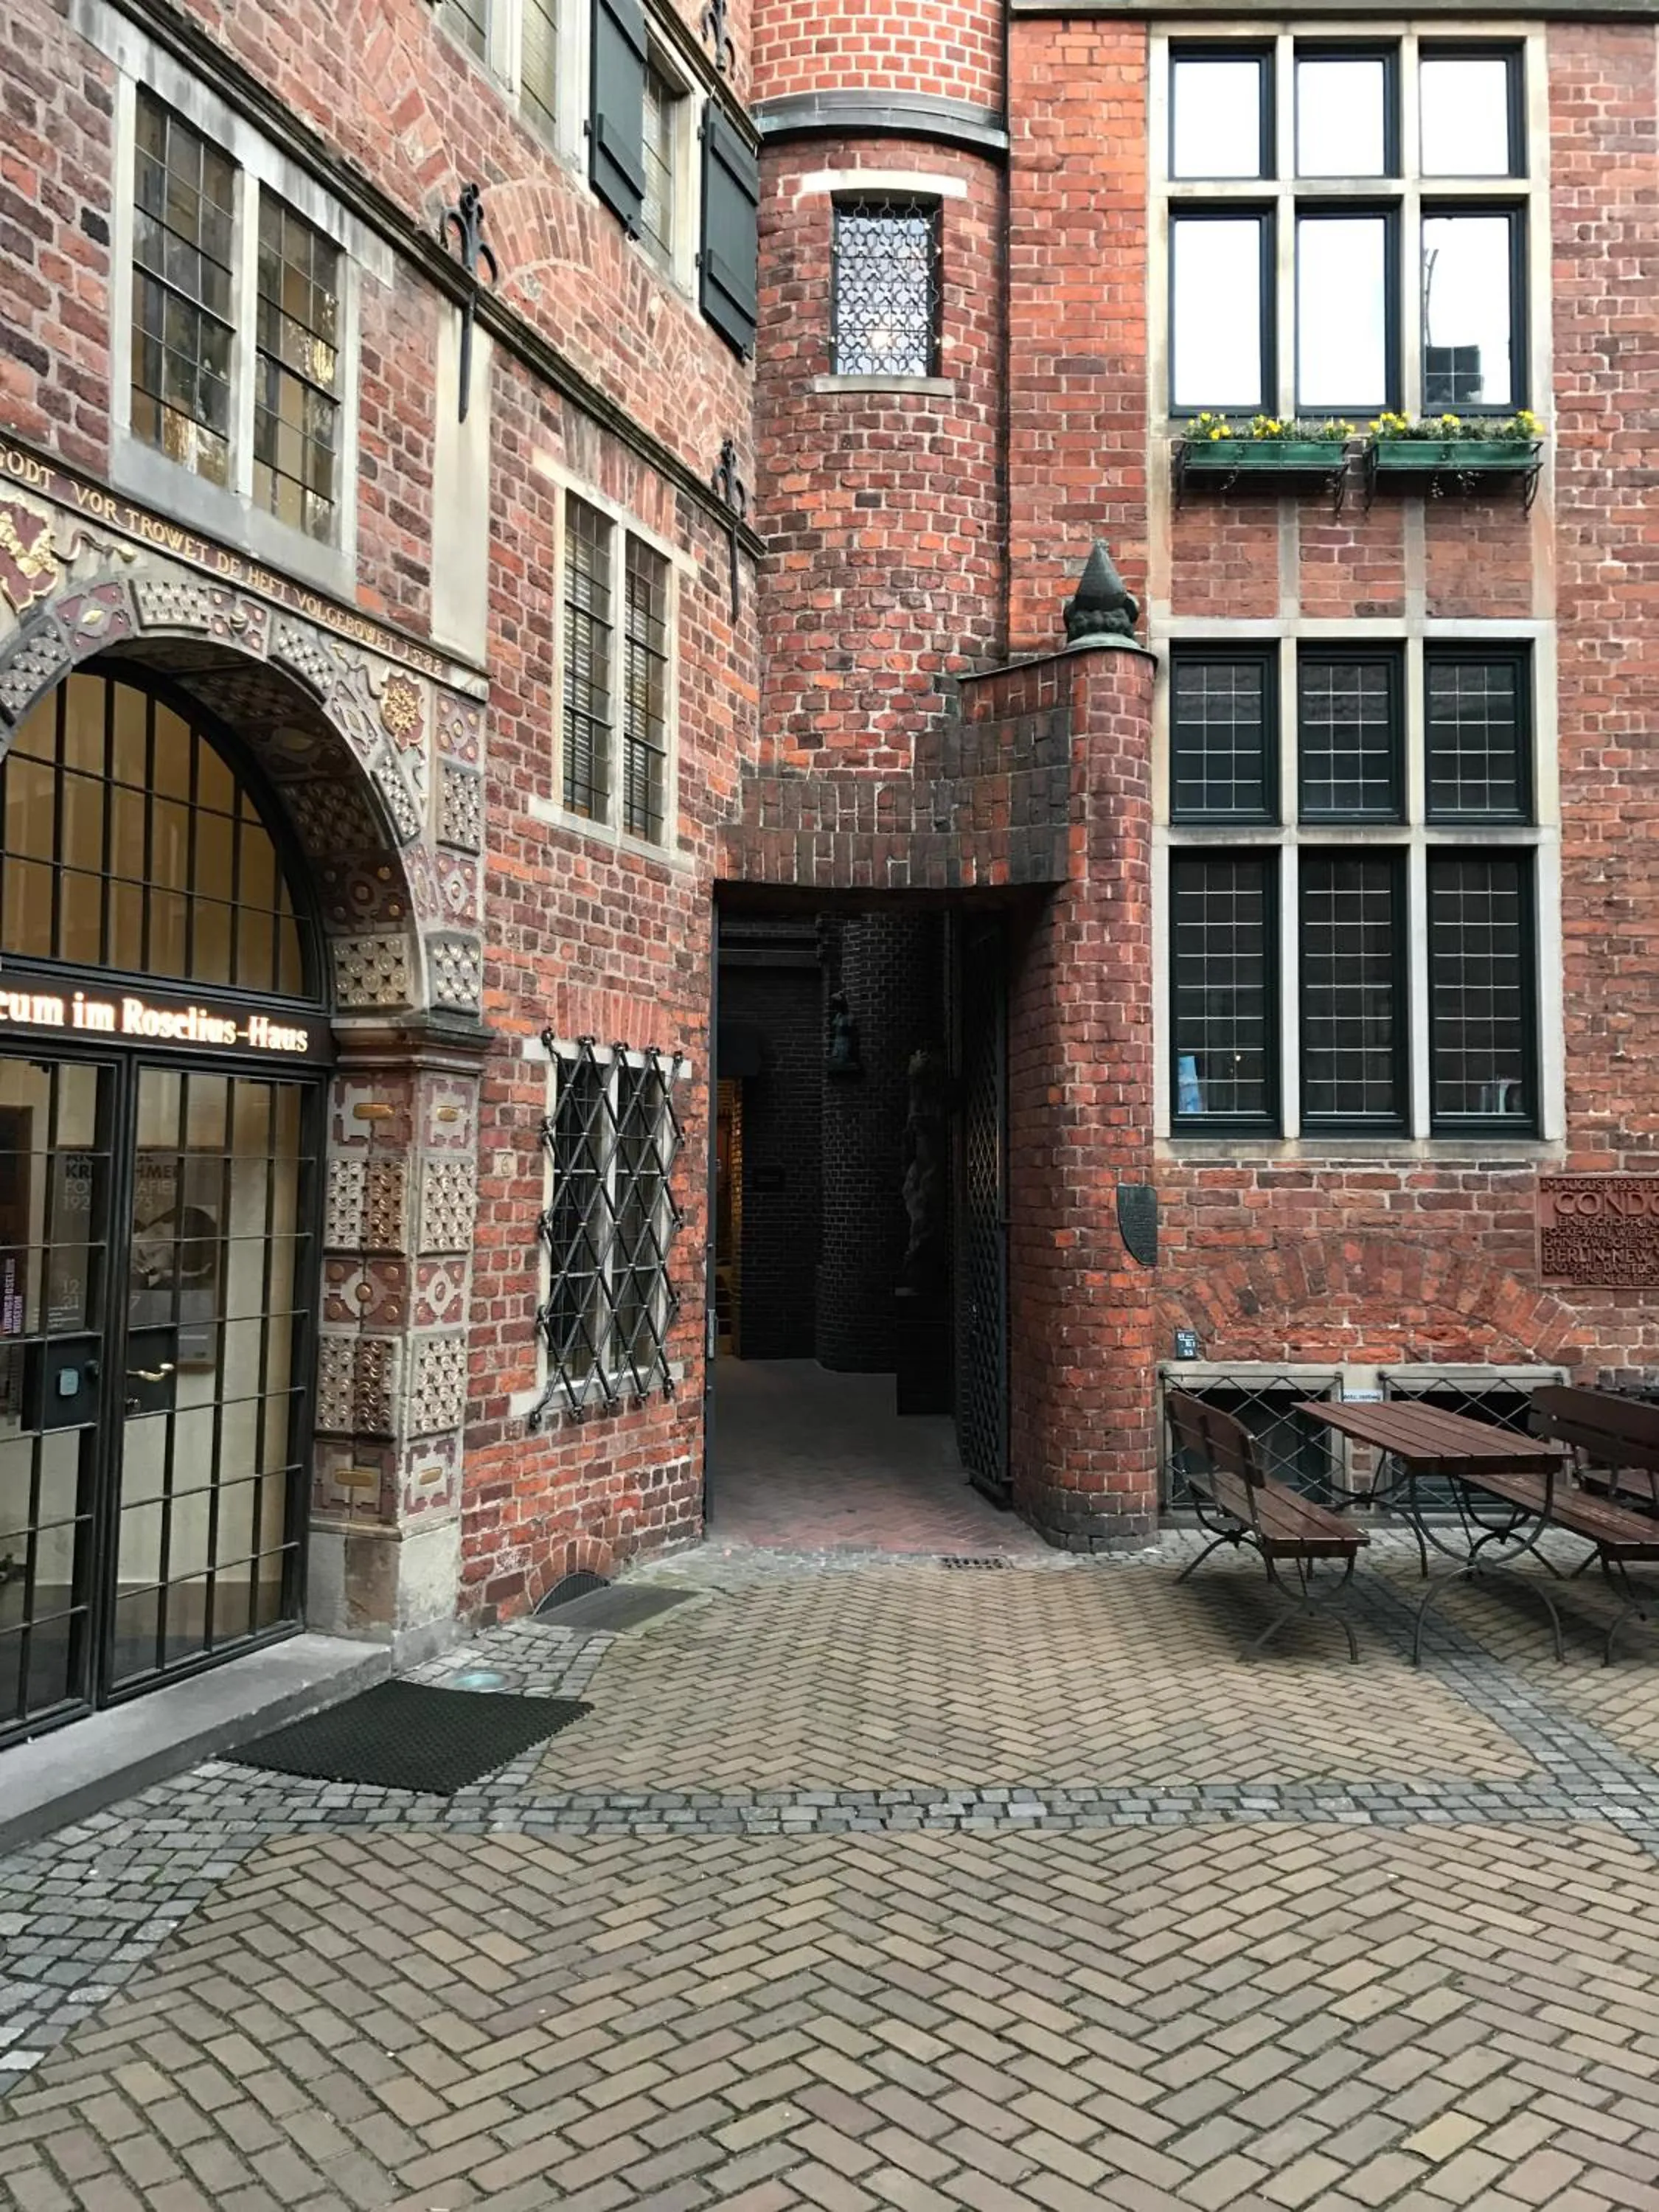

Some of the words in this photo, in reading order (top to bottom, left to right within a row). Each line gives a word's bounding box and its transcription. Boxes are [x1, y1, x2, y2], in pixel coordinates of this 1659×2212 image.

[71, 480, 128, 529] VOR
[125, 508, 209, 563] TROWET
[216, 551, 241, 579] DE
[247, 565, 290, 601] HEFT
[72, 991, 116, 1032] im
[122, 997, 308, 1052] Roselius-Haus
